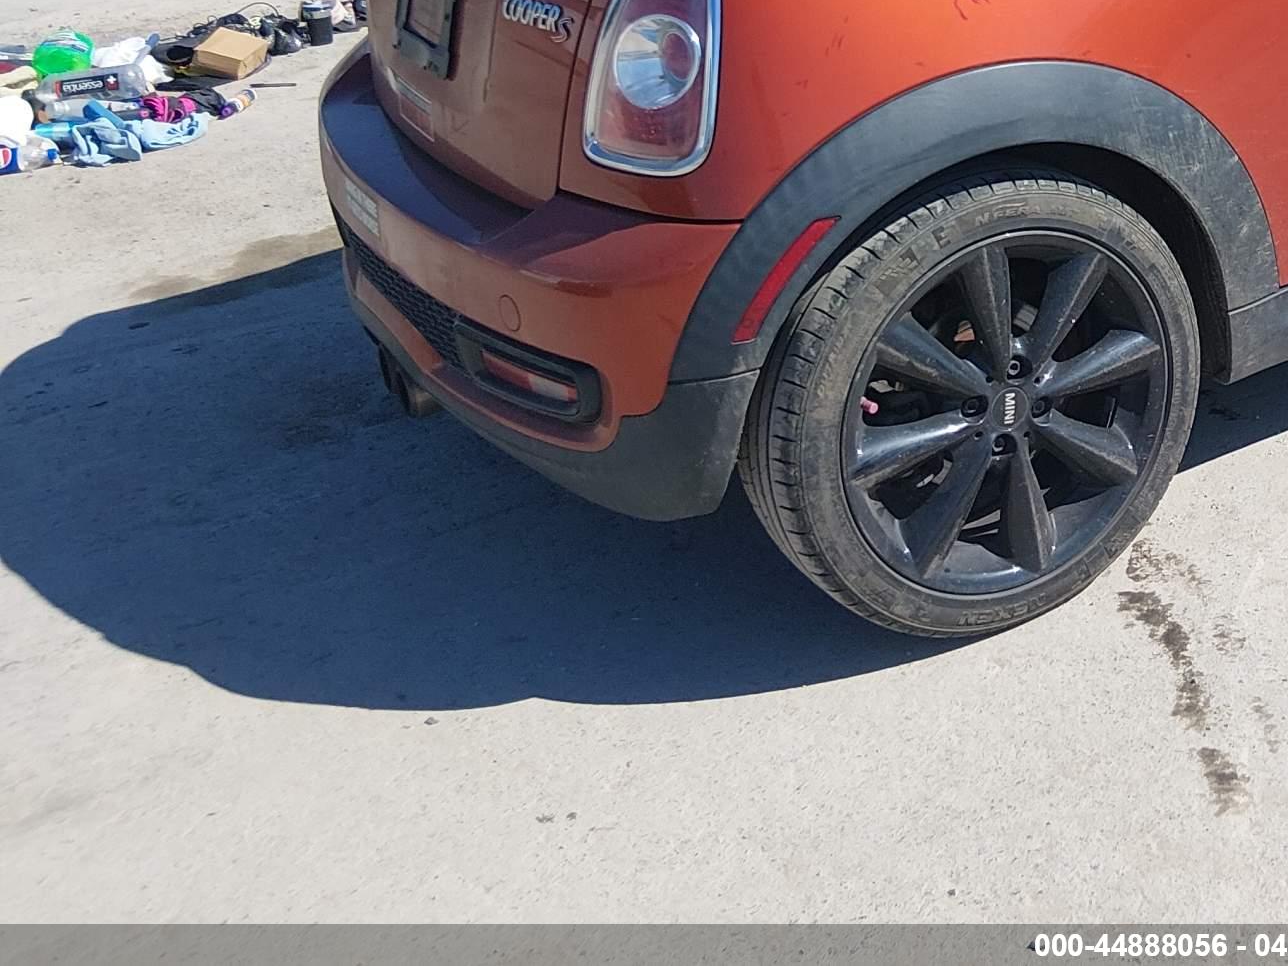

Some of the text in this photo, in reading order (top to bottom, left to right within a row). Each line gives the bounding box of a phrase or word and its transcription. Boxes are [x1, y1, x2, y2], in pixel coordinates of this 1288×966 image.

[550, 17, 574, 43] S
[62, 79, 104, 94] essentia
[1003, 392, 1016, 425] MINI
[957, 592, 1047, 626] NEXEN
